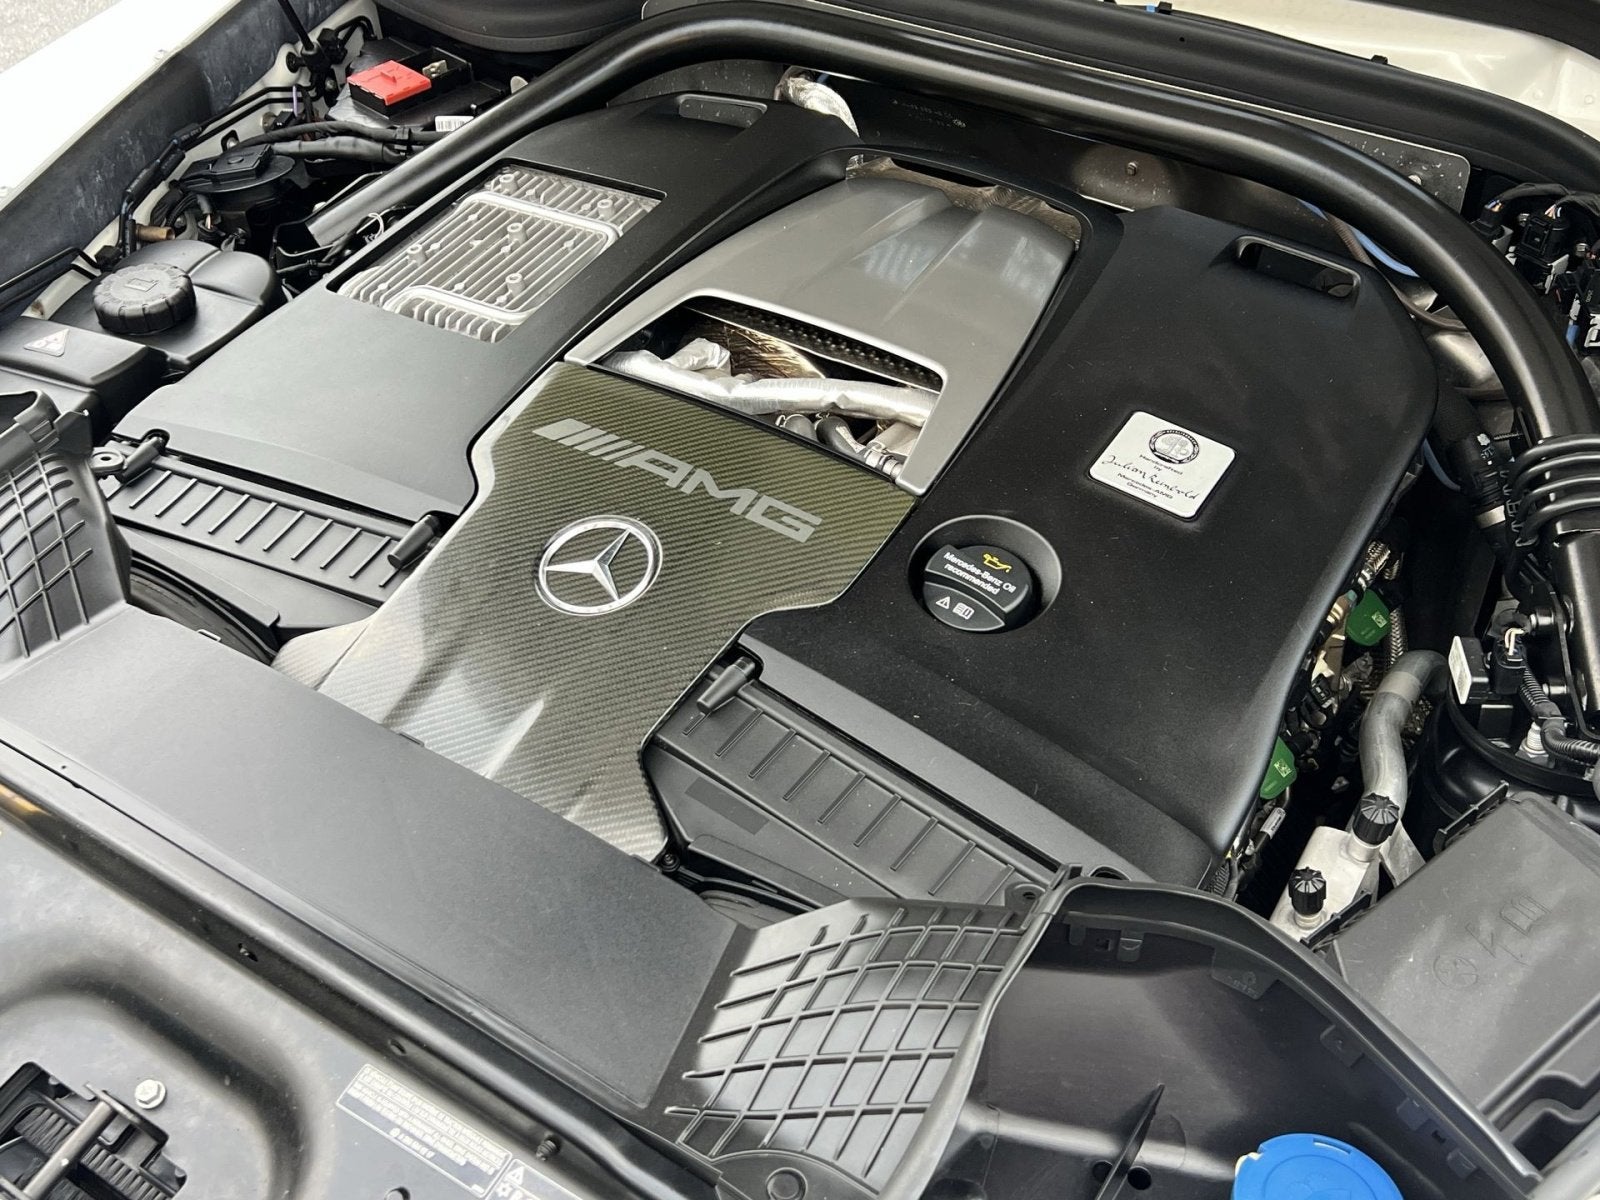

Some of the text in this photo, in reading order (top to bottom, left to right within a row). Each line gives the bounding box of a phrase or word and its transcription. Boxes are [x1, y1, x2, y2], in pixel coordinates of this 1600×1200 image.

[614, 449, 822, 543] AMG
[943, 552, 1017, 593] Mercedes-Benz Oil
[944, 563, 1000, 595] recommended
